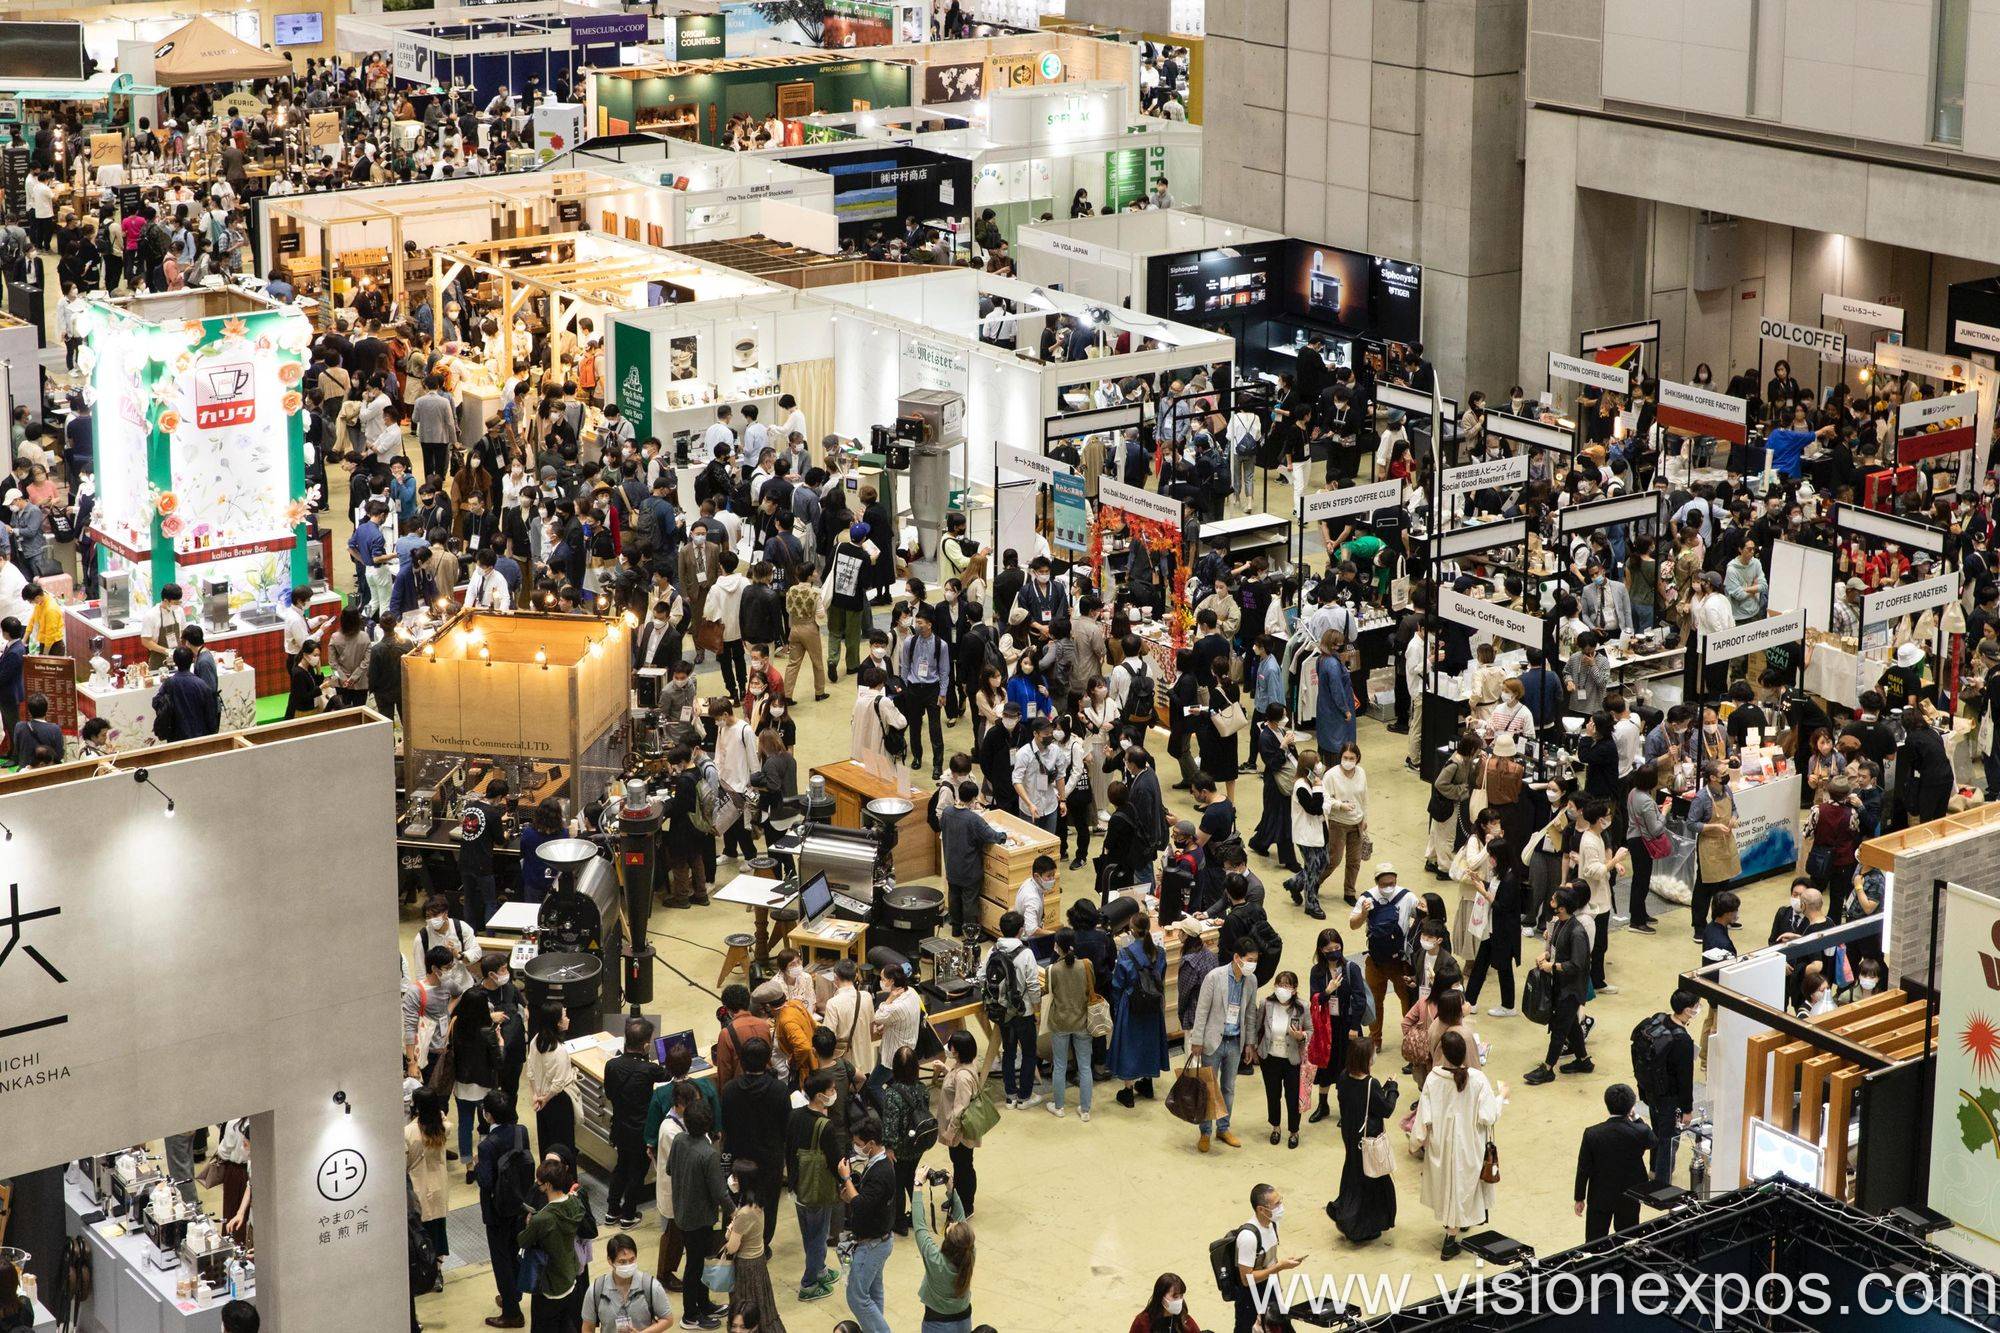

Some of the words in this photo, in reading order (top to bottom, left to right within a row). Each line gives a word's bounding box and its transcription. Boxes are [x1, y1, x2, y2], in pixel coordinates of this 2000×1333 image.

[681, 30, 706, 38] ORIGIN
[681, 36, 721, 47] COUNTRIES
[229, 99, 254, 107] KEURIG
[1073, 246, 1088, 255] JAPAN
[1170, 265, 1199, 274] Siphonysta
[1381, 268, 1418, 285] Siphonysta
[1761, 320, 1842, 352] QOLCOFFE
[1960, 329, 1990, 340] JUNCTION
[917, 346, 953, 369] Meister
[1553, 360, 1581, 374] NUTSTOWN
[1581, 368, 1600, 379] COFFEE
[1600, 372, 1624, 385] ISHIGAKI
[1664, 389, 1694, 402] SHIKISHIMA
[1694, 396, 1715, 408] COFFEE
[1715, 401, 1741, 413] FACTORY
[199, 405, 254, 424] カリタ
[1442, 481, 1460, 492] Social
[1461, 478, 1477, 488] Good
[1478, 474, 1504, 485] Roasters
[1134, 496, 1152, 509] coffee
[1153, 503, 1177, 517] roasters
[1309, 501, 1331, 512] SEVEN
[1332, 497, 1353, 507] STEPS
[1353, 492, 1378, 504] COFFEE
[1378, 488, 1396, 499] CLUB
[211, 550, 232, 560] kalita
[234, 547, 253, 557] Brew
[254, 545, 268, 554] Bar
[1875, 601, 1885, 611] 27
[1885, 595, 1912, 608] COFFEE
[1912, 584, 1948, 601] ROASTERS
[1454, 602, 1476, 617] Gluck
[1478, 610, 1505, 626] Coffee
[1506, 619, 1526, 633] Spot
[1712, 634, 1746, 651] TAPROOT
[1746, 629, 1770, 642] coffee
[1770, 621, 1799, 636] roasters
[431, 734, 471, 746] Northern
[1751, 815, 1766, 825] crop
[1736, 829, 1750, 840] from
[1752, 826, 1764, 834] San
[318, 1220, 369, 1245] 焙煎所
